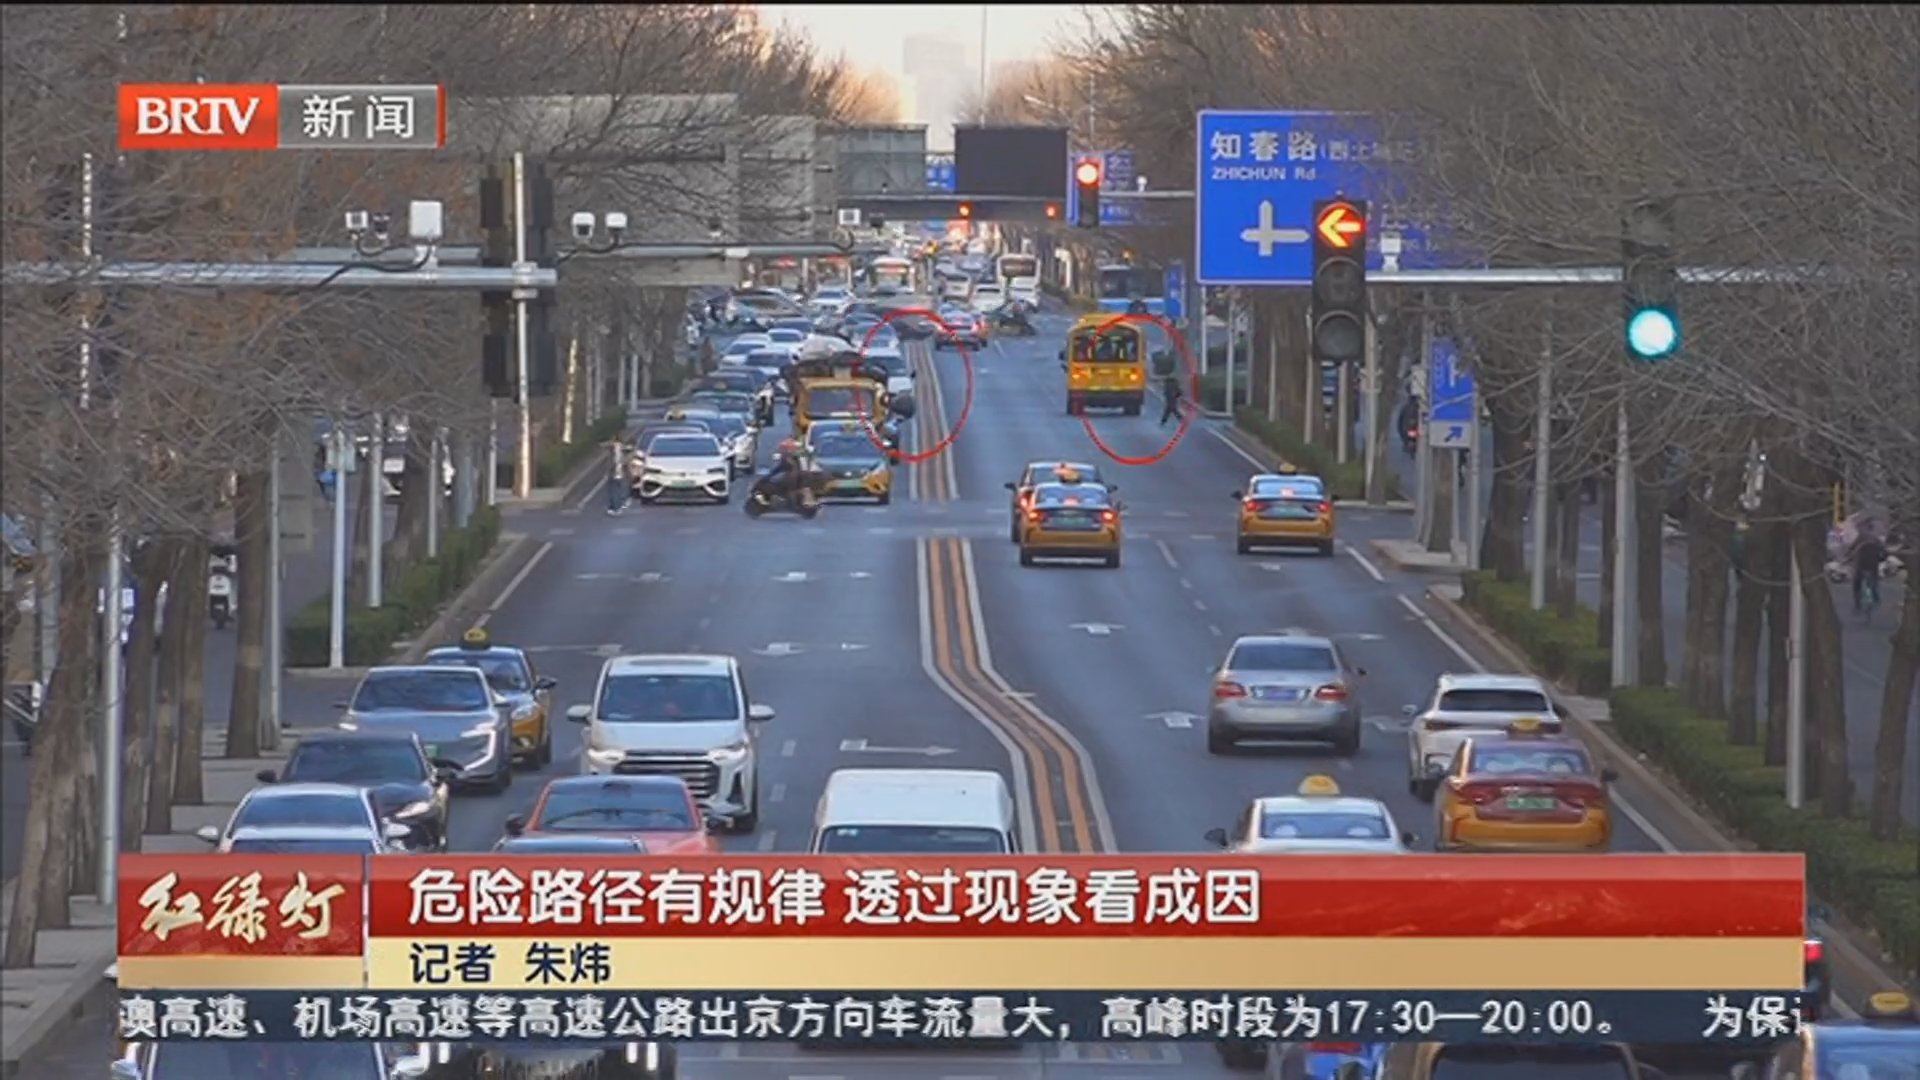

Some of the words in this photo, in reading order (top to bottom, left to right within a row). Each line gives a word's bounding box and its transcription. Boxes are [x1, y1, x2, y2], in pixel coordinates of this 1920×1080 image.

[1210, 130, 1317, 161] 知春路
[1211, 166, 1286, 181] ZHICHUN
[1294, 167, 1316, 180] Rd
